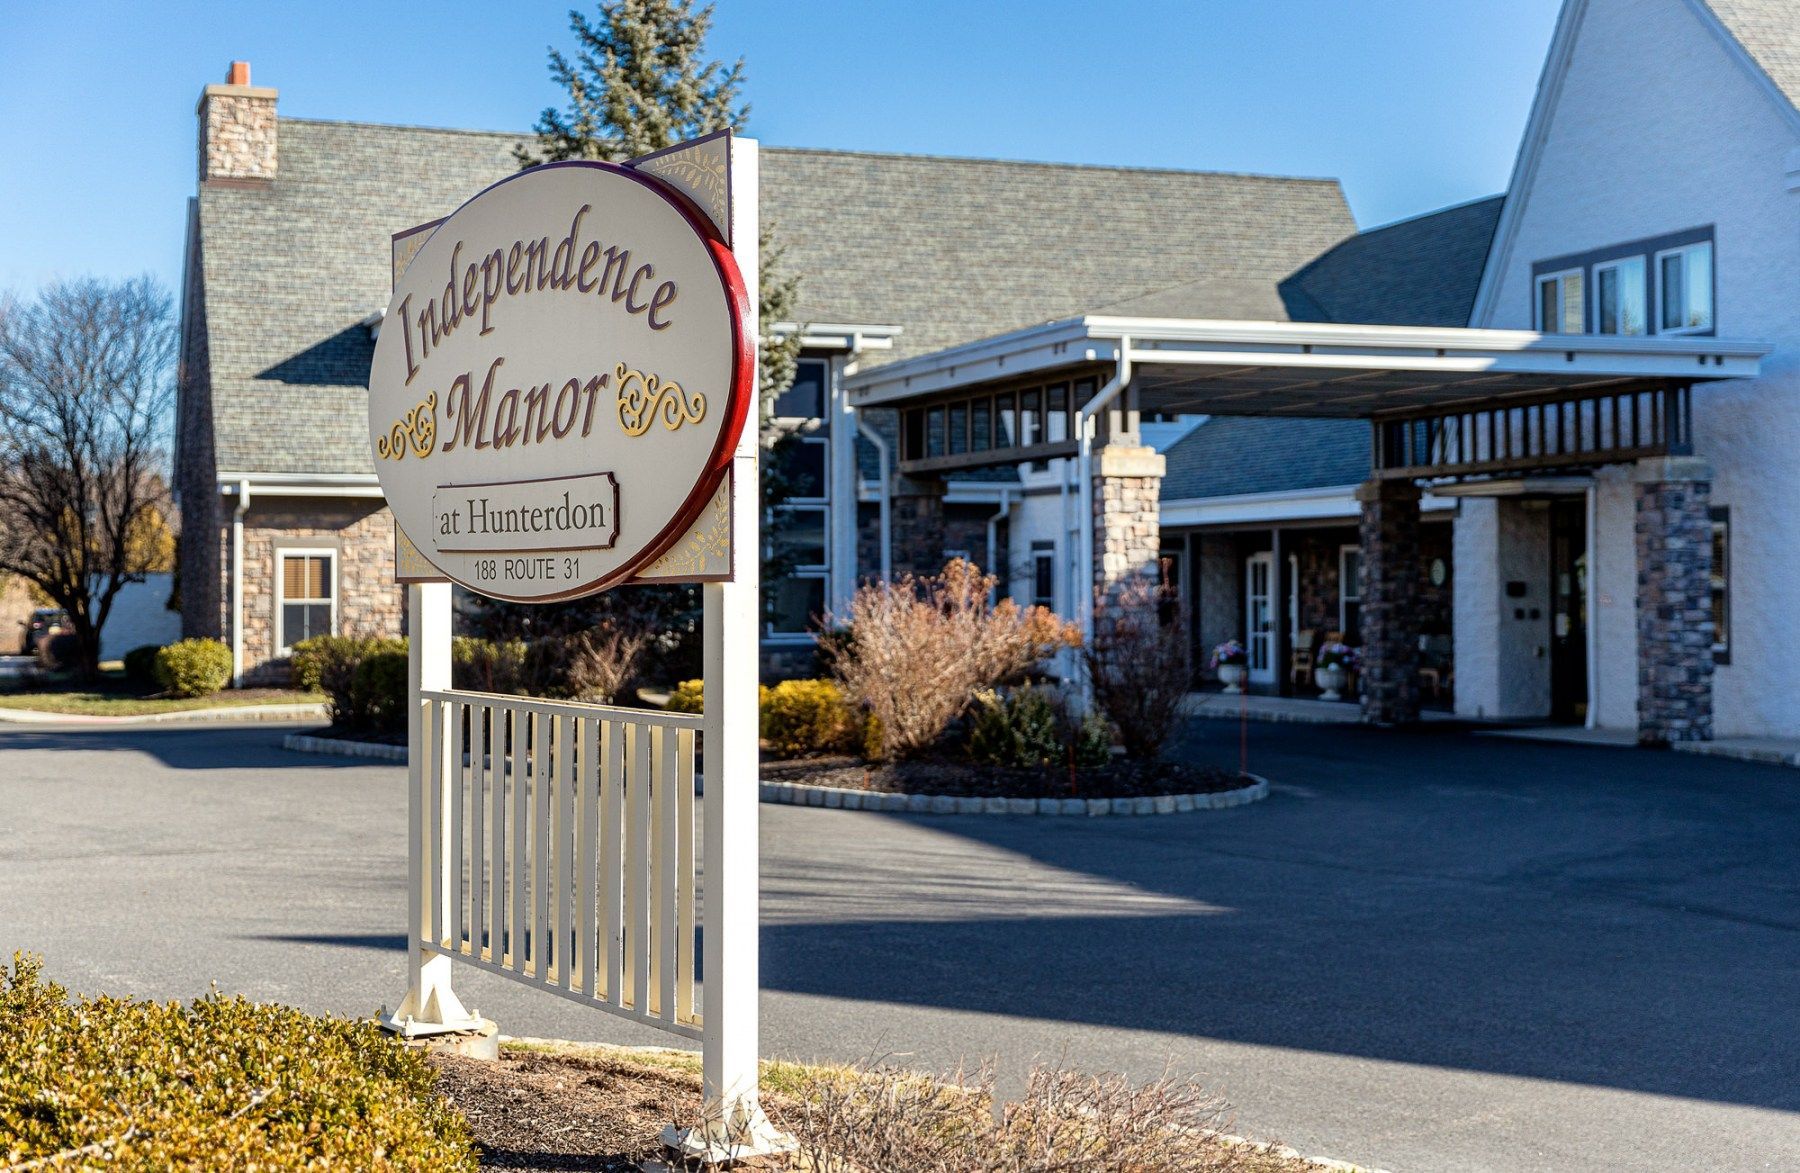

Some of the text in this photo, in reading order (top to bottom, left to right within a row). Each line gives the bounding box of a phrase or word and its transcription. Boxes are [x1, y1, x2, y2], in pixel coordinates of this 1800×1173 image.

[397, 204, 677, 386] Independence
[441, 356, 610, 454] Manor
[440, 492, 606, 535] at Hunterdon
[474, 557, 580, 581] 188 ROUTE 31
